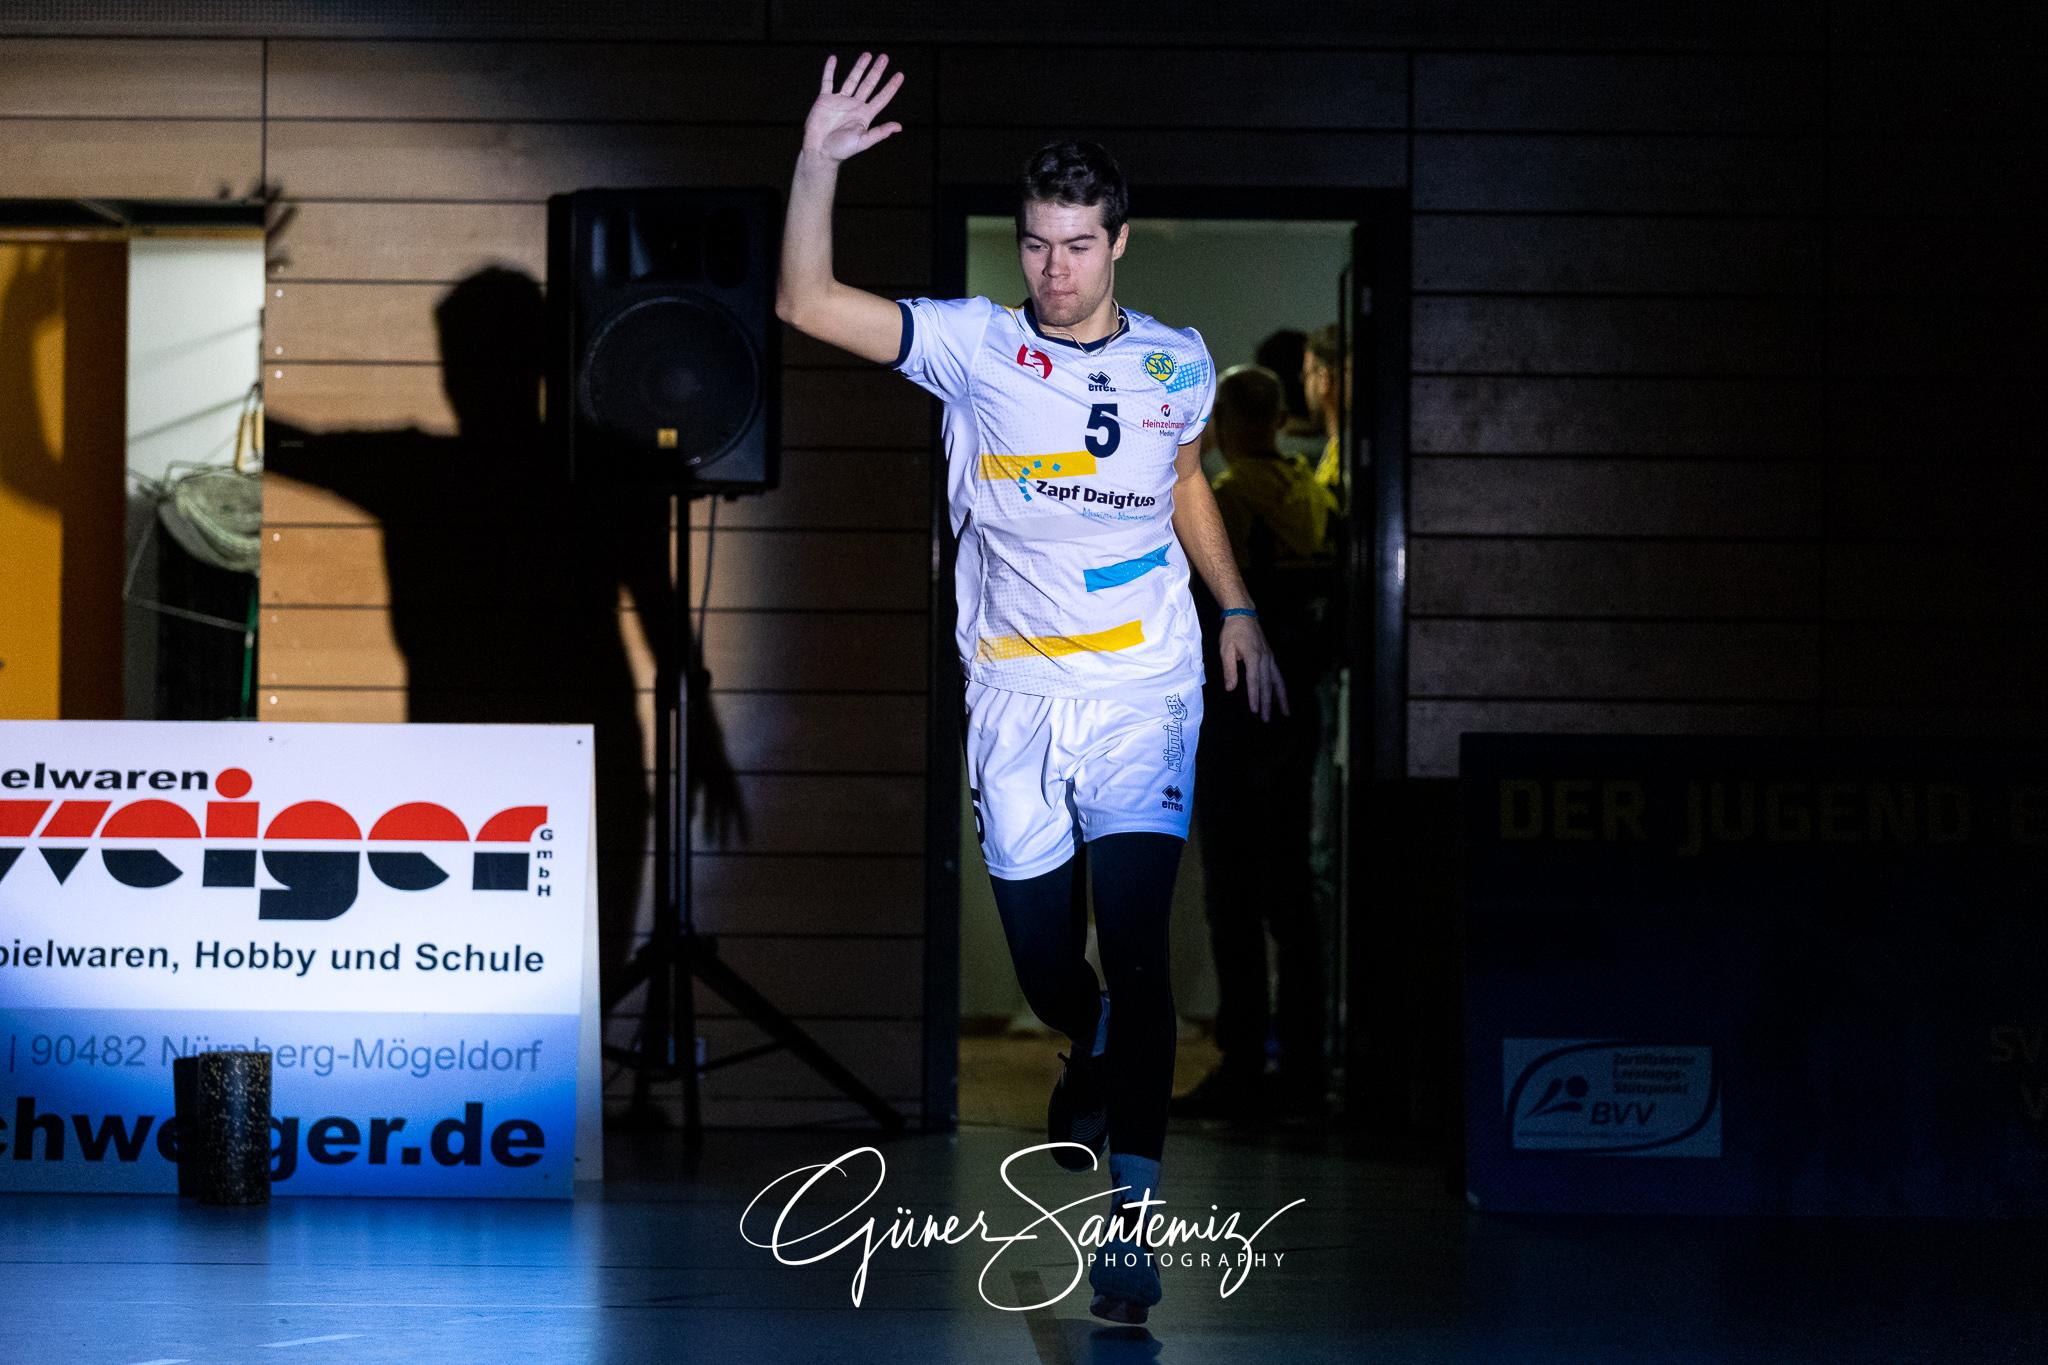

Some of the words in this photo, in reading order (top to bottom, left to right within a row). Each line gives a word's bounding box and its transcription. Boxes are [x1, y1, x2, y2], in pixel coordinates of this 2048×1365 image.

[1085, 403, 1121, 458] 5
[1036, 480, 1080, 501] Zapf
[1162, 800, 1183, 812] errea
[1499, 778, 1647, 841] DER
[1677, 780, 1971, 857] JUGEND
[196, 940, 317, 977] Hobby
[330, 943, 400, 970] und
[415, 943, 545, 973] Schule
[31, 1034, 147, 1067] 90482
[1590, 1101, 1656, 1125] BVV
[0, 1096, 545, 1183] hwger.de
